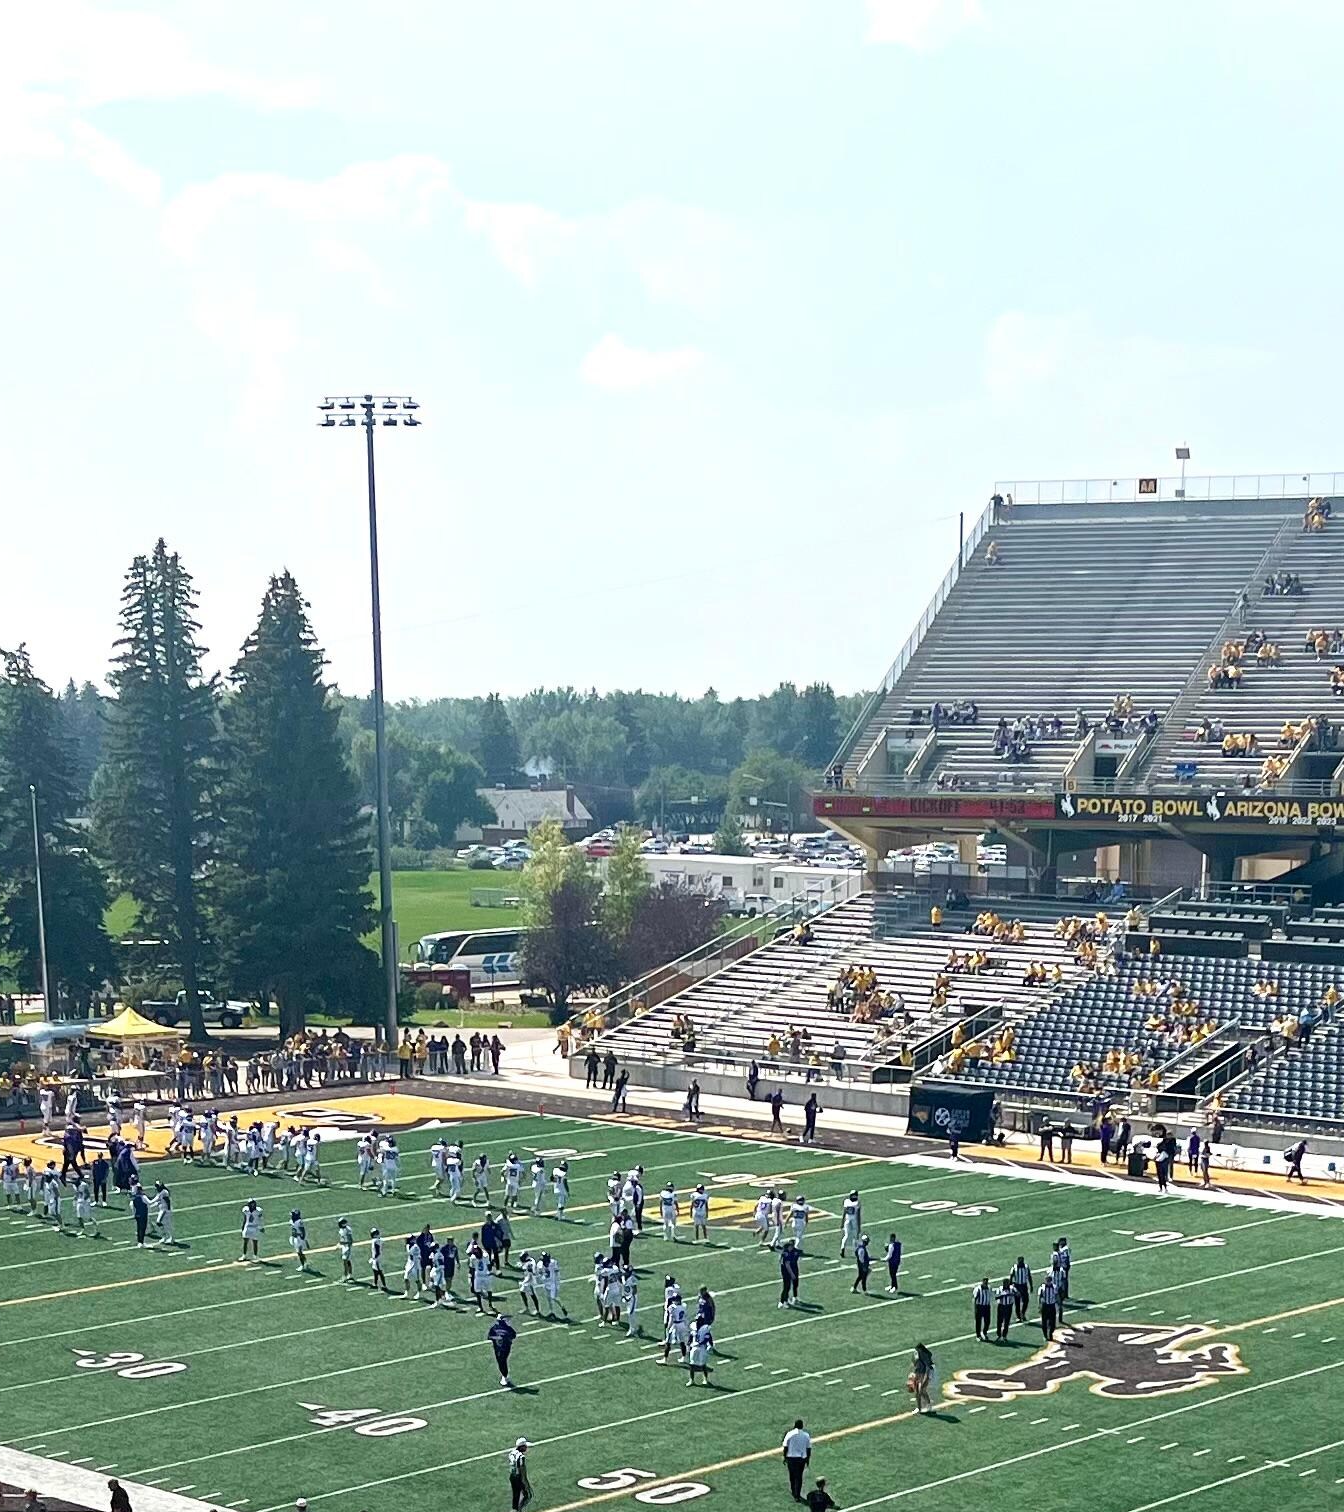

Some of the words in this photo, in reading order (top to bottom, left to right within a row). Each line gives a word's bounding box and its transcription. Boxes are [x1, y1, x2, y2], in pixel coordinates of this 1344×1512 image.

[1077, 798, 1146, 815] POTATO
[1153, 800, 1204, 817] BOWL
[1224, 801, 1300, 818] ARIZONA
[1133, 1230, 1227, 1248] 40
[75, 1352, 187, 1379] 30
[309, 1408, 428, 1436] 40
[577, 1468, 711, 1505] 50
